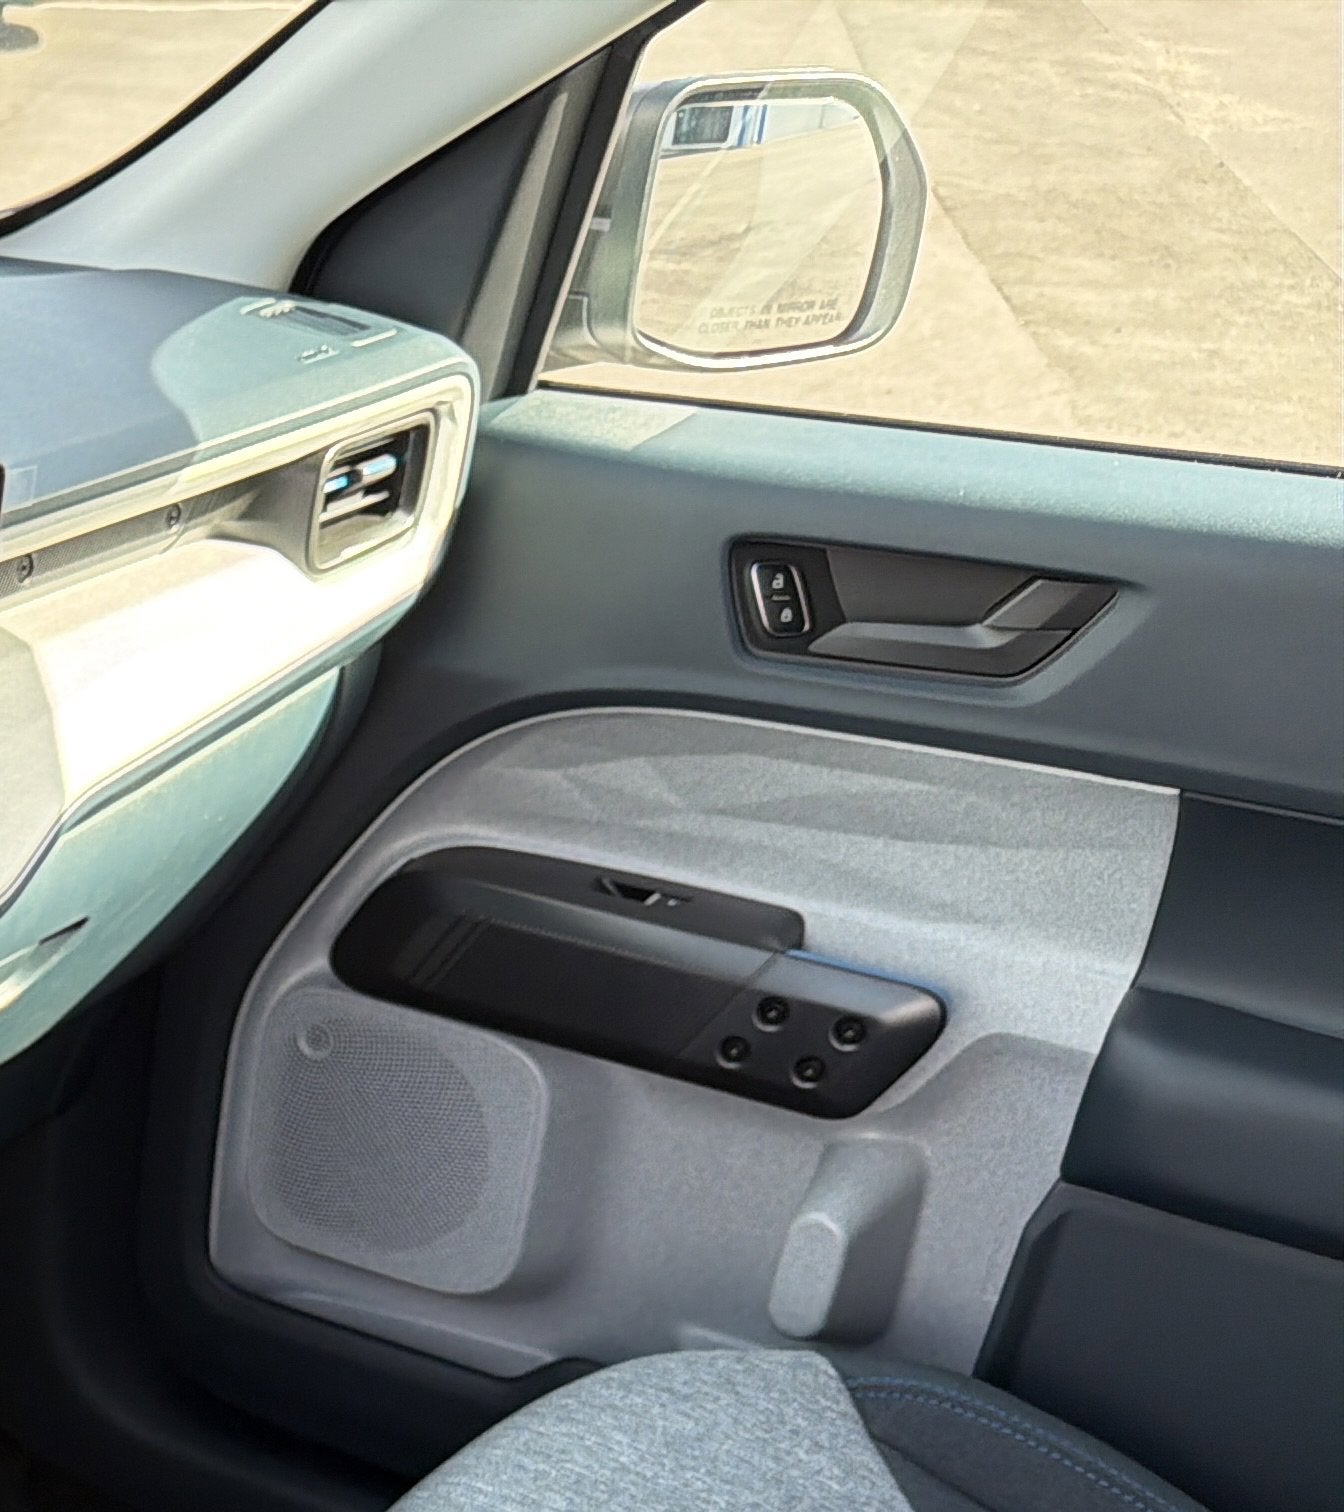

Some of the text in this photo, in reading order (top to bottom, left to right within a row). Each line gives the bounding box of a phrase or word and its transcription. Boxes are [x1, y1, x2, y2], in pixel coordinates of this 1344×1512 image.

[709, 297, 838, 319] OBJECTS IN MIRROR ARE
[698, 320, 740, 335] CLOSER
[744, 318, 772, 330] THAN
[775, 316, 801, 328] THEY
